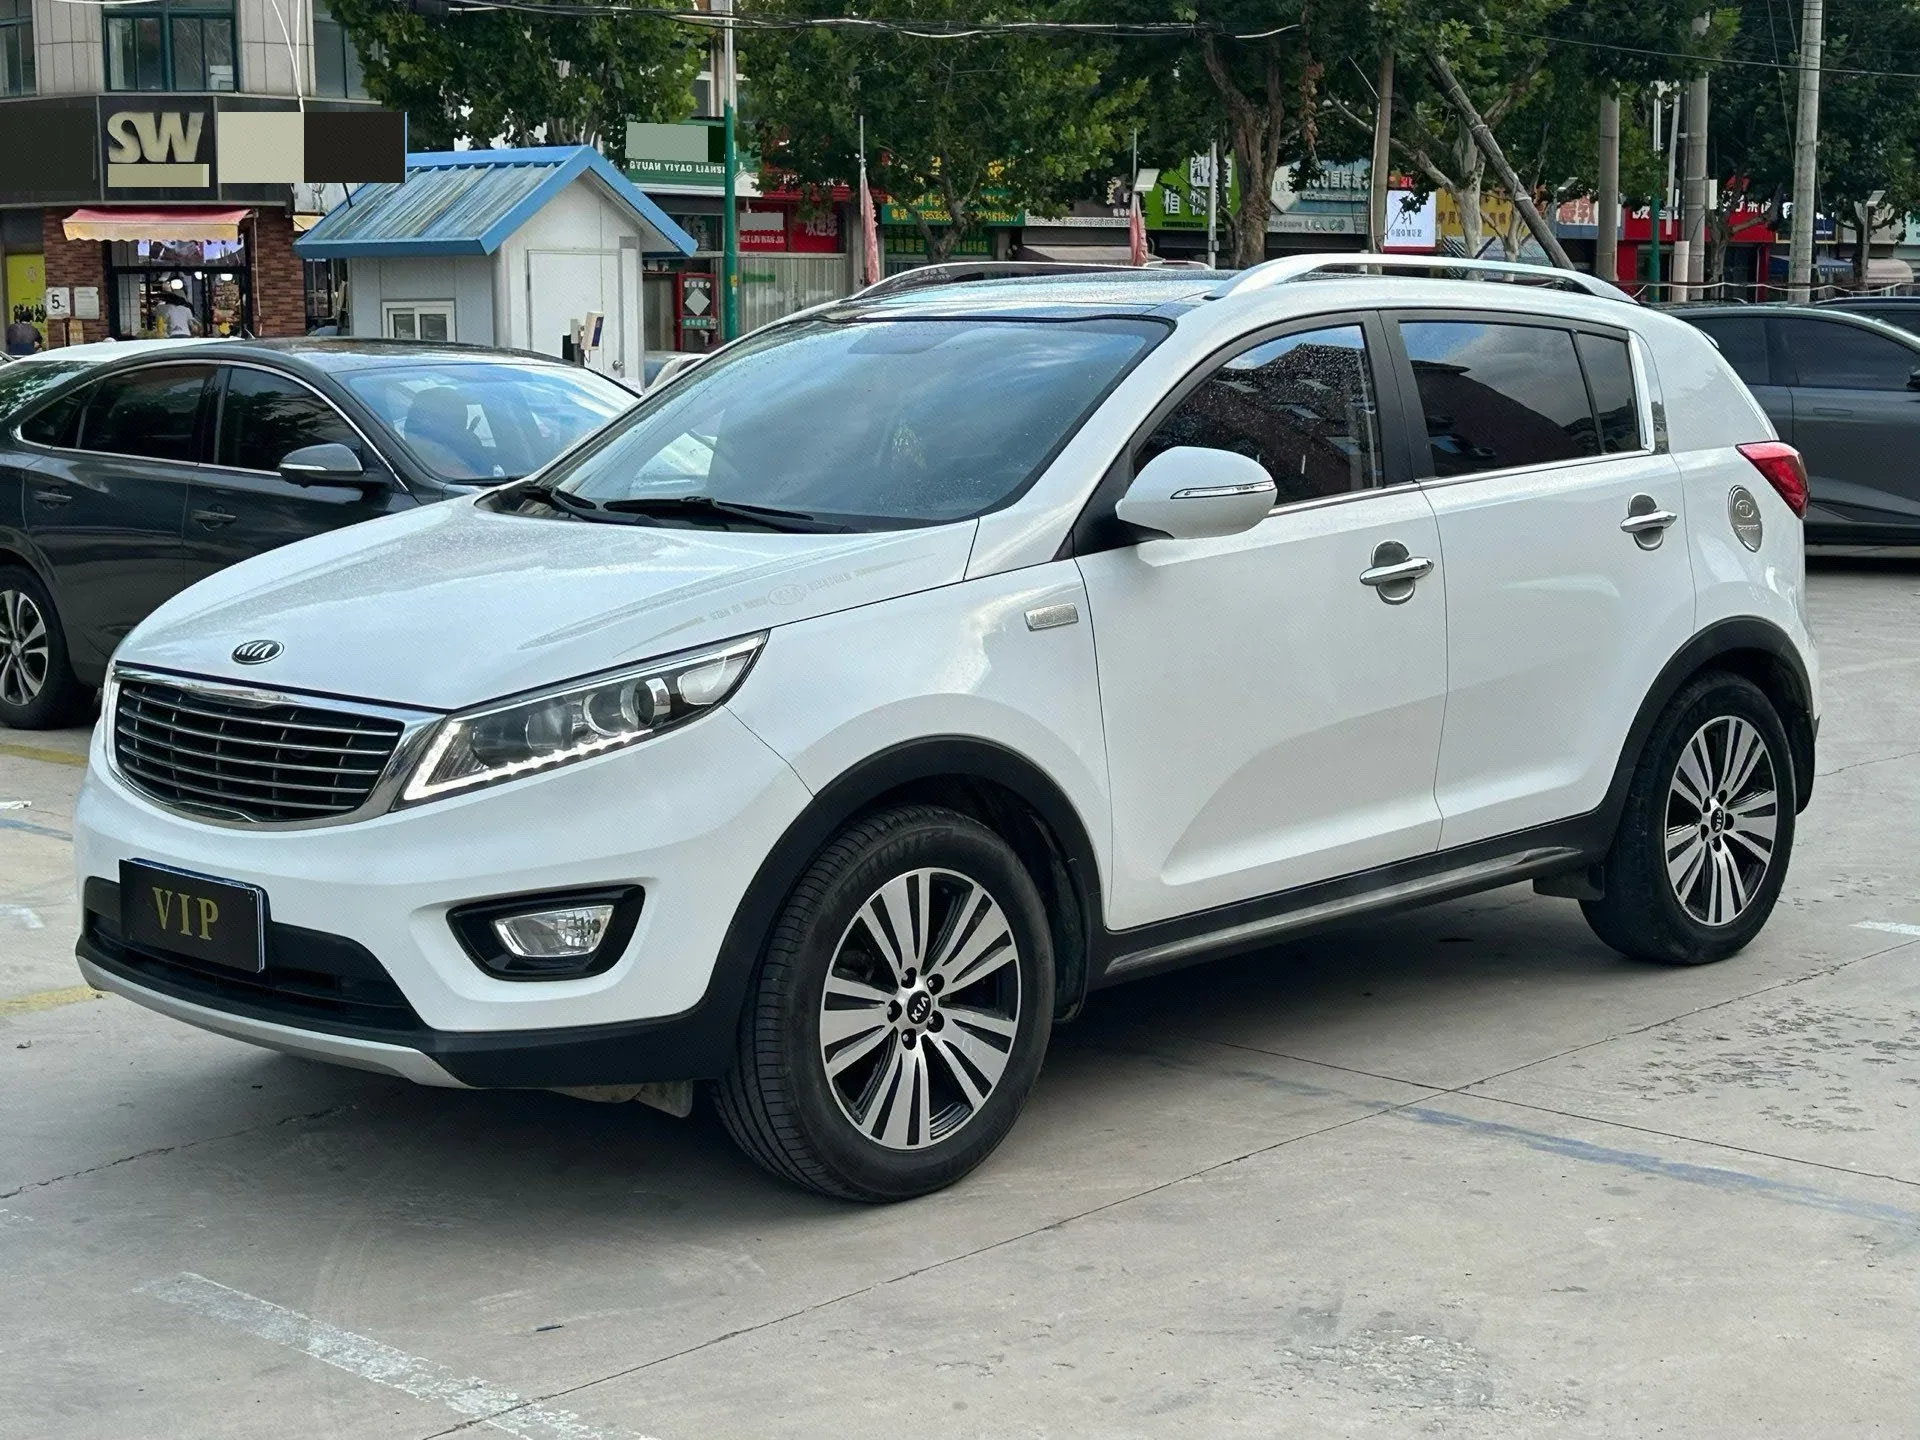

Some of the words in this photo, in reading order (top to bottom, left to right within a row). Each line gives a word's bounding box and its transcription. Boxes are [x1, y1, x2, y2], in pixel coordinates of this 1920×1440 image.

[107, 112, 204, 163] SW
[664, 163, 693, 172] YIYAO
[695, 164, 726, 174] LIANS
[235, 641, 276, 659] KIA
[152, 886, 219, 940] VIP
[911, 996, 929, 1021] KIA
